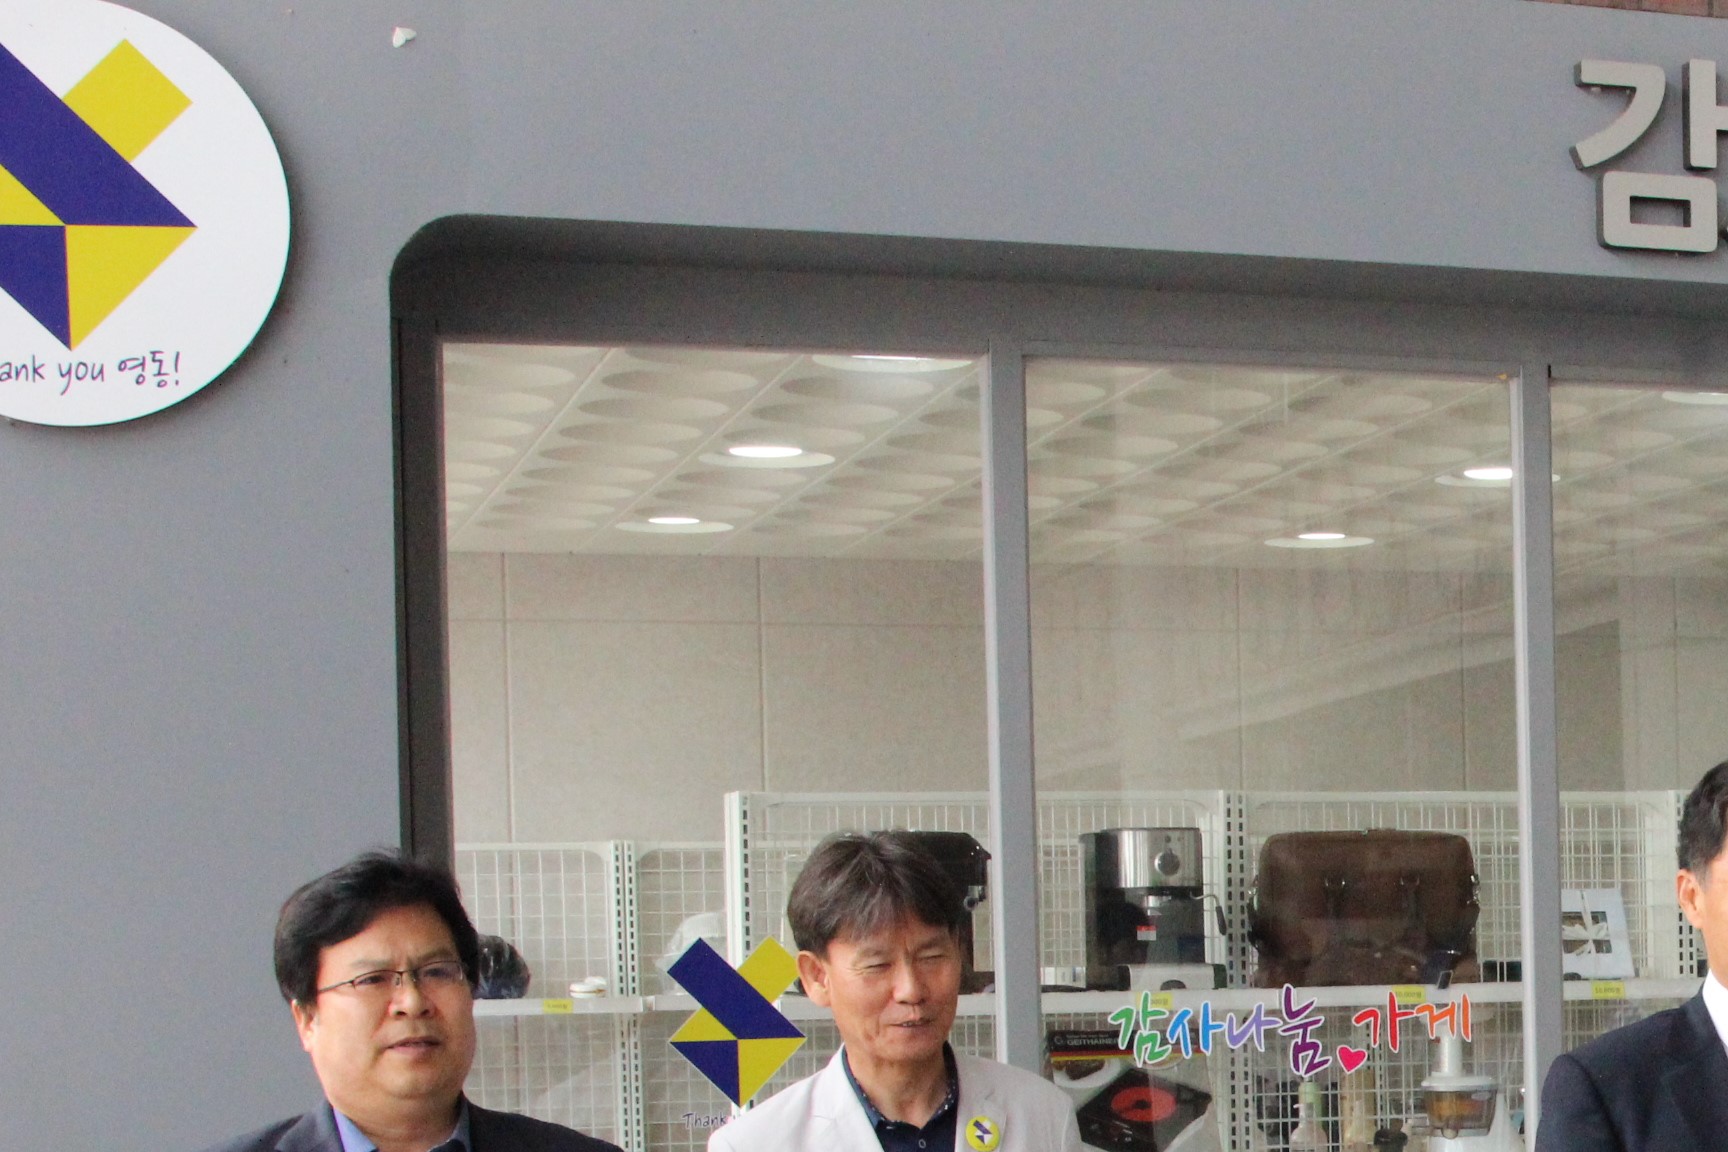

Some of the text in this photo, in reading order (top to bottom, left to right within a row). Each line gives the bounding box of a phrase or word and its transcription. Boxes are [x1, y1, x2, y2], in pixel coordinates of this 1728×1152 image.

[58, 362, 105, 396] you
[117, 350, 181, 388] 영동!
[1108, 984, 1473, 1078] 감사나눔 가게
[682, 1111, 727, 1129] Thank
